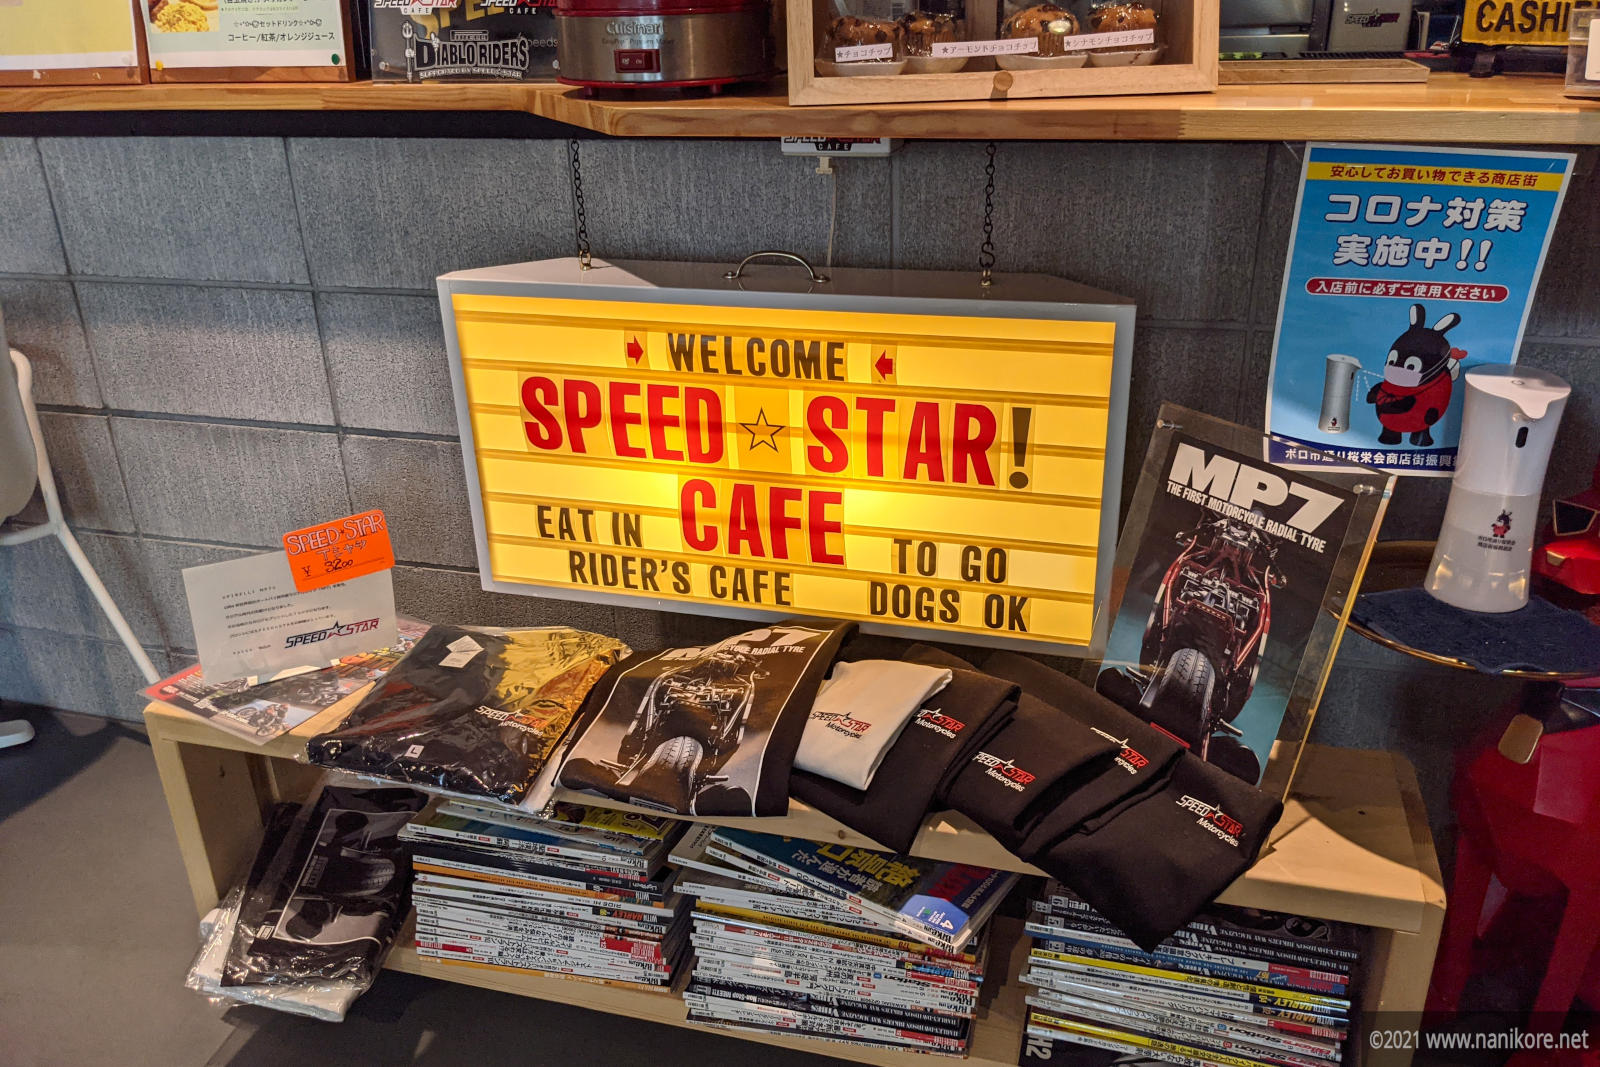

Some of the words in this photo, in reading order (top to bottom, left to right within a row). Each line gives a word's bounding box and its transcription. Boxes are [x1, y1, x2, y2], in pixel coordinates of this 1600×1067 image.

[606, 21, 664, 35] Cuisinart
[477, 36, 529, 71] RIDERS
[1330, 164, 1538, 188] 安心してお買い物できる商店街
[1324, 193, 1528, 232] コロナ対策
[1315, 279, 1497, 300] 入店前に必ずご使用ください
[667, 332, 845, 382] WELCOME
[520, 376, 725, 464] SPEED
[1169, 442, 1345, 533] MP7
[537, 505, 594, 542] EAT
[611, 511, 643, 548] IN
[680, 479, 846, 565] CAFE
[1166, 481, 1182, 497] THE
[1182, 486, 1207, 506] FIRST
[1208, 496, 1265, 530] MOTORCYCLE
[1265, 520, 1297, 542] RADIAL
[1299, 533, 1327, 553] TYRE
[285, 527, 340, 556] SPEED
[343, 512, 384, 540] STAR
[893, 538, 938, 577] TO
[961, 545, 1008, 584] GO
[569, 550, 692, 595] RIDER'S
[709, 564, 792, 607] CAFE
[869, 581, 961, 624] DOGS
[984, 593, 1028, 633] OK
[285, 630, 328, 648] SPEED
[345, 618, 380, 636] STAR
[783, 645, 806, 654] TYRE
[809, 711, 839, 721] SPEED
[914, 718, 957, 739] Motorcycles
[935, 713, 966, 733] STAR
[1120, 748, 1150, 768] STAR
[985, 768, 1025, 792] Motorcycles
[1009, 767, 1036, 784] STAR
[1176, 795, 1210, 817] SPEED
[1218, 813, 1243, 838] STAR
[1196, 817, 1239, 847] Motorcycles
[1273, 997, 1312, 1010] HARLEY
